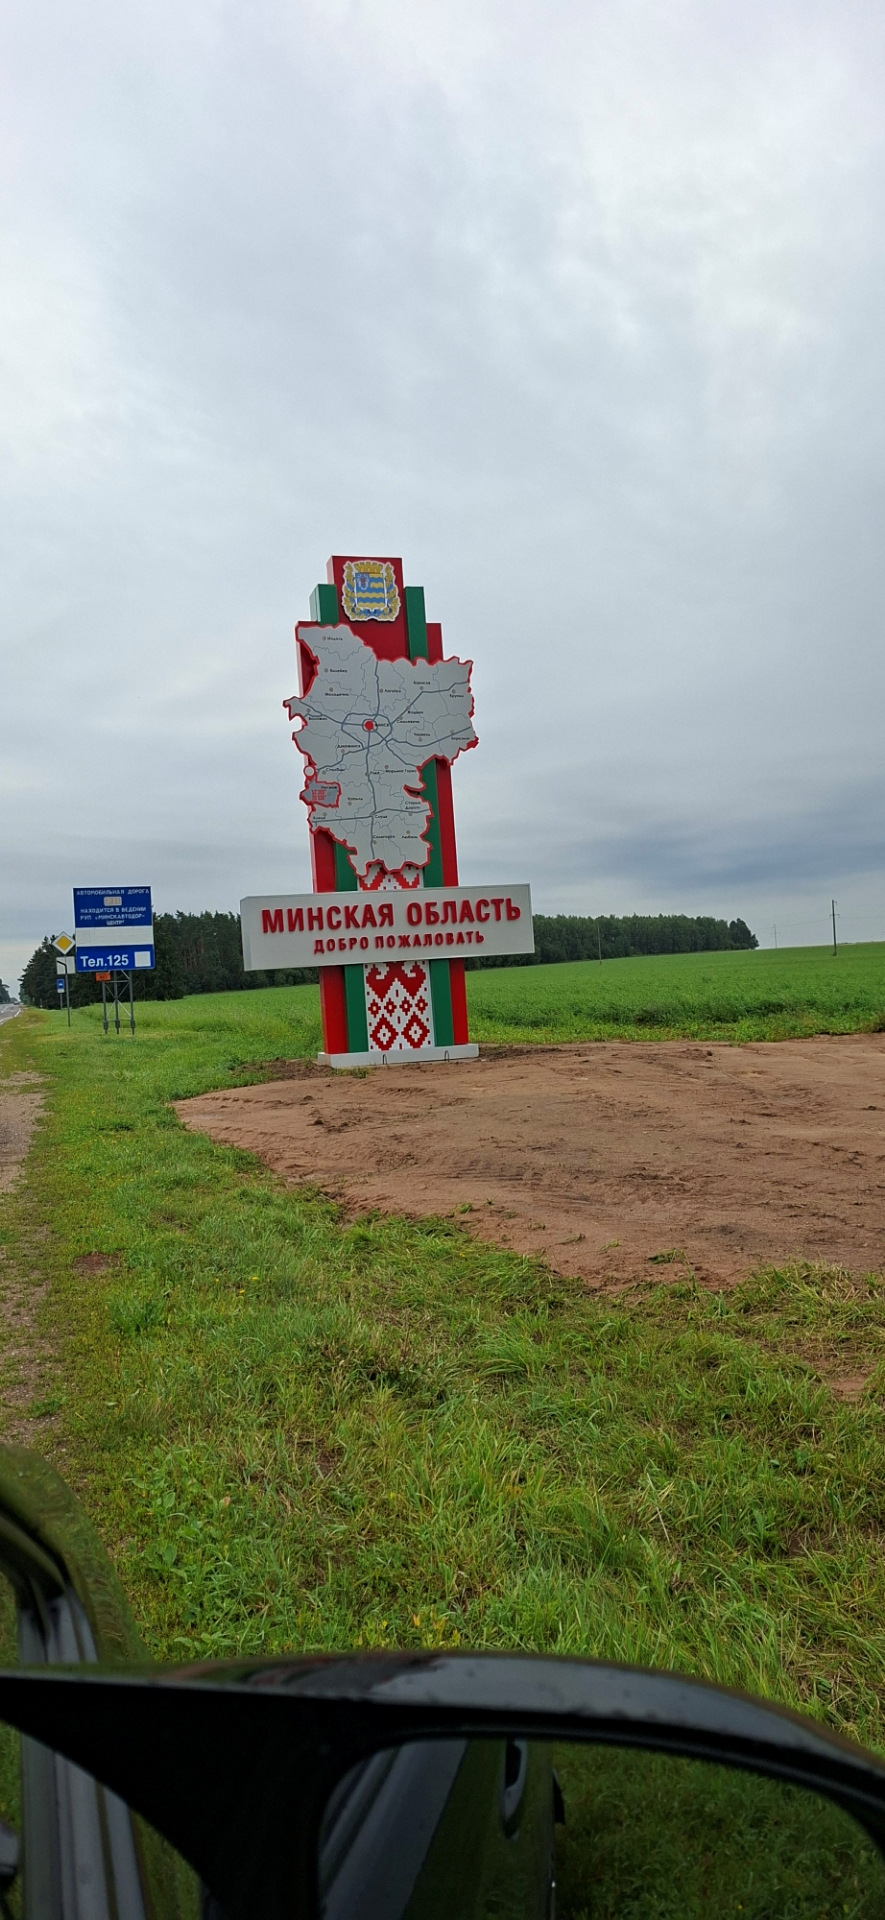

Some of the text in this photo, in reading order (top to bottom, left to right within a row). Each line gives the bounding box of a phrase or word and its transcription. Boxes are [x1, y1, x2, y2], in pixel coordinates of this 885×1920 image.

[261, 897, 521, 933] МИНСКАЯ ОБЛАСТЬ
[314, 930, 485, 955] ДОБРО ПОЖАЛОВАТЬ
[80, 954, 129, 967] Тел.125
